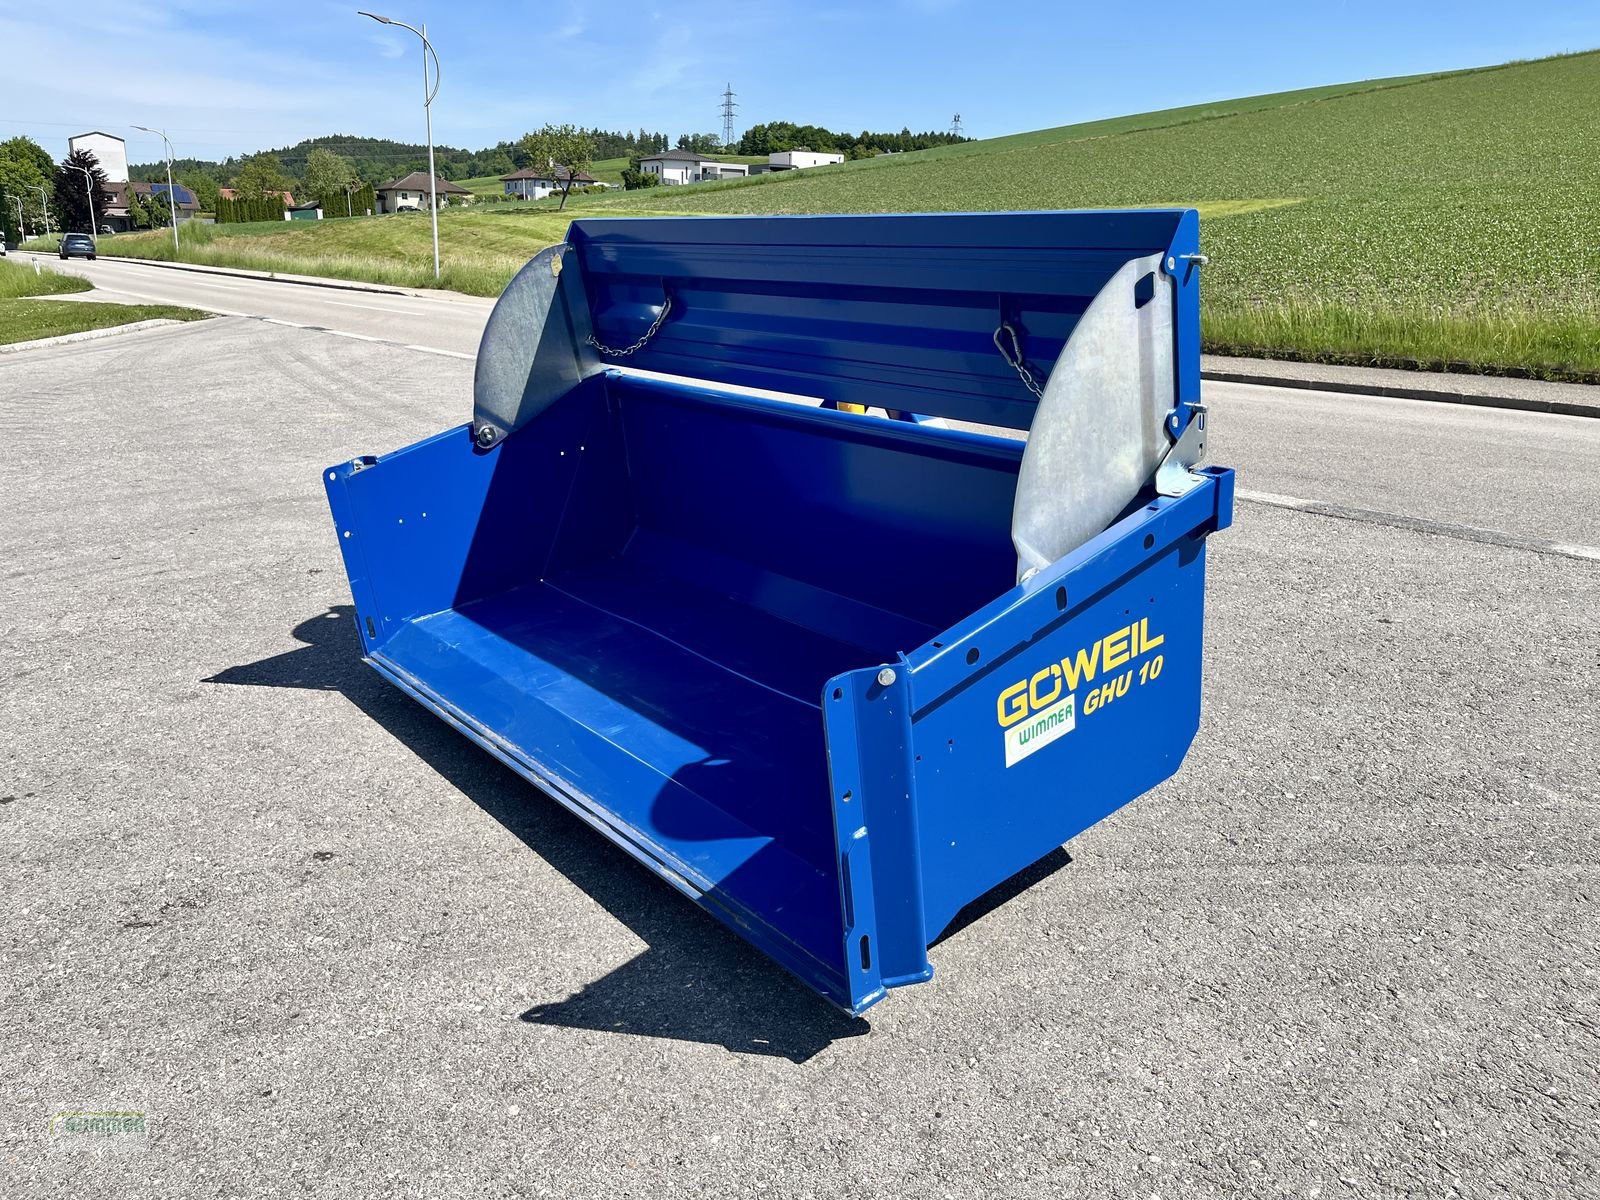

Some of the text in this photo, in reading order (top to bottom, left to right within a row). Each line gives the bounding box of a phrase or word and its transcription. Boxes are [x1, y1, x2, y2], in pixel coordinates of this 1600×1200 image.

[1083, 655, 1164, 715] GHU 10
[1019, 704, 1073, 745] WIMMER
